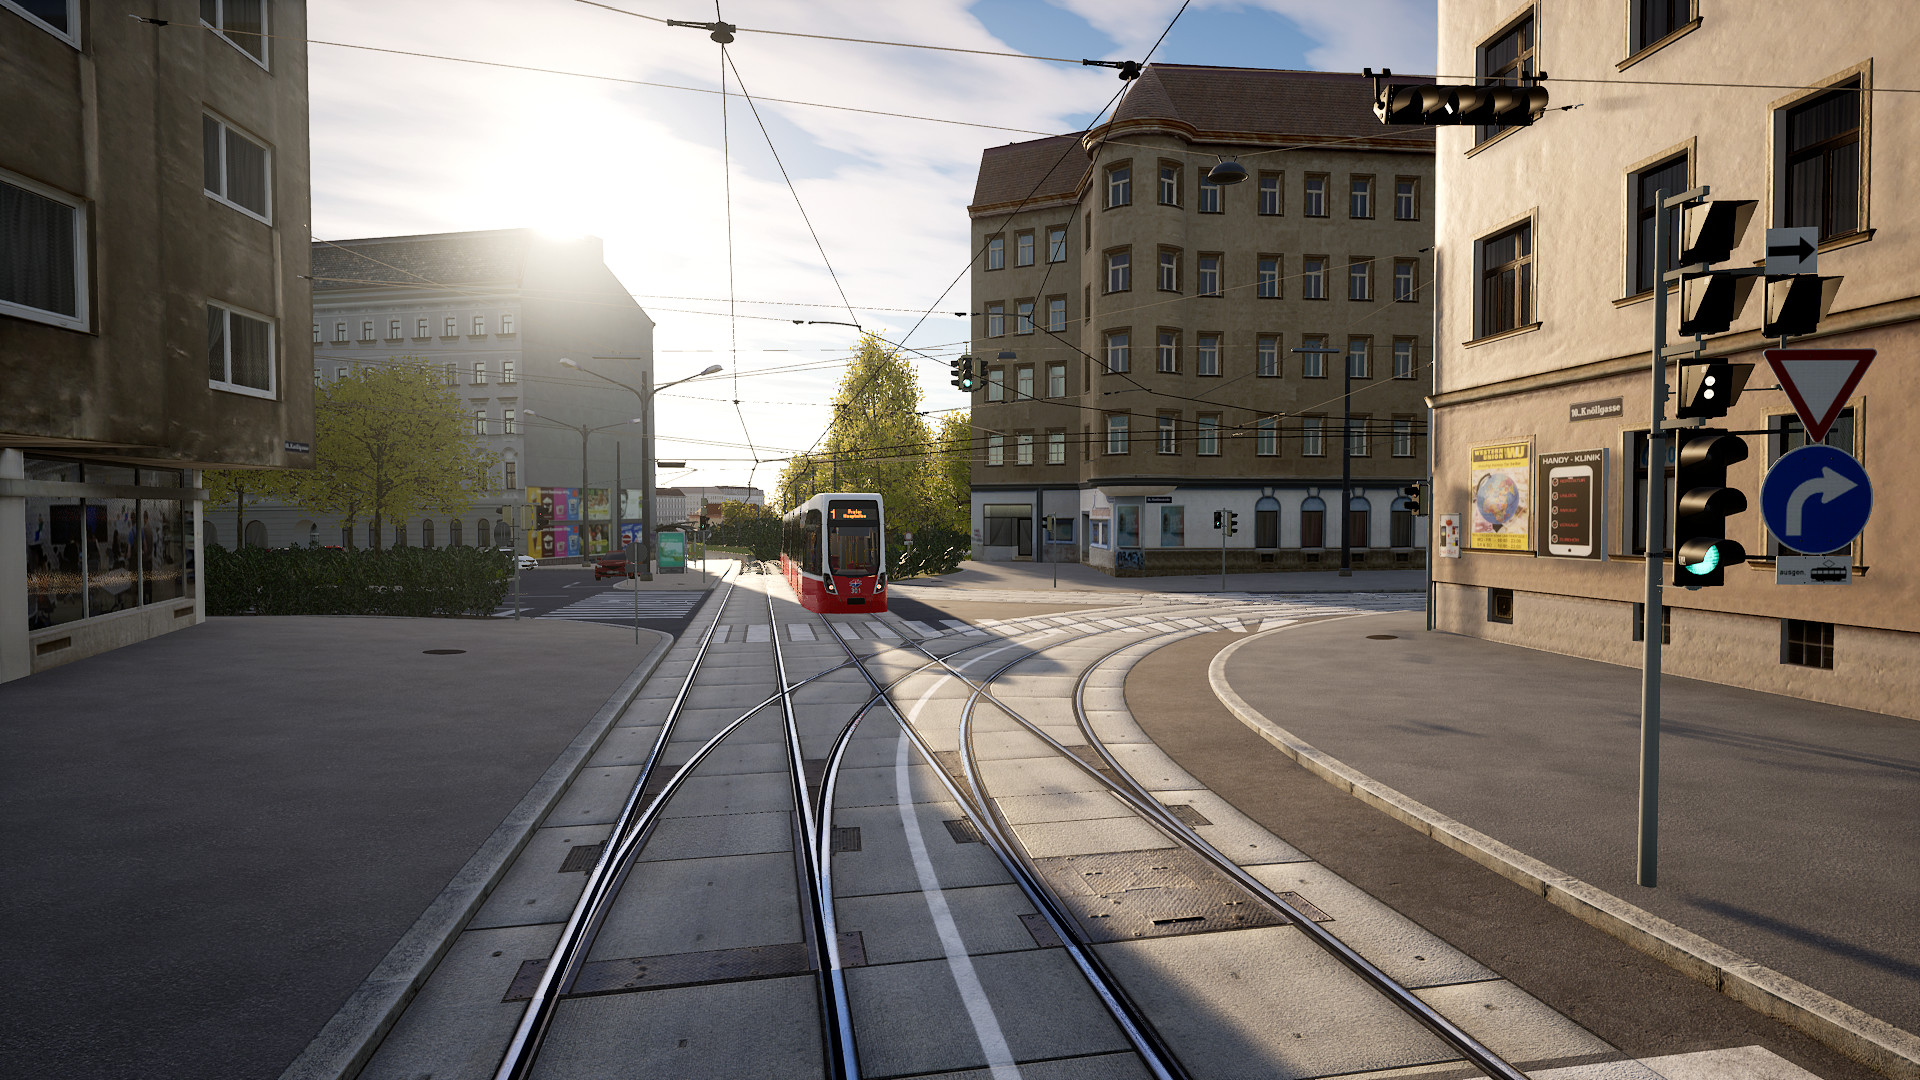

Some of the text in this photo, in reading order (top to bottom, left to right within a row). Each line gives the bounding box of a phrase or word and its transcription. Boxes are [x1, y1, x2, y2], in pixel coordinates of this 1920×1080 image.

[1474, 447, 1503, 456] WESTERN
[1542, 456, 1569, 465] HANDY
[1574, 453, 1601, 463] KLINIK
[830, 508, 836, 520] 1
[1780, 569, 1806, 577] ausgen.
